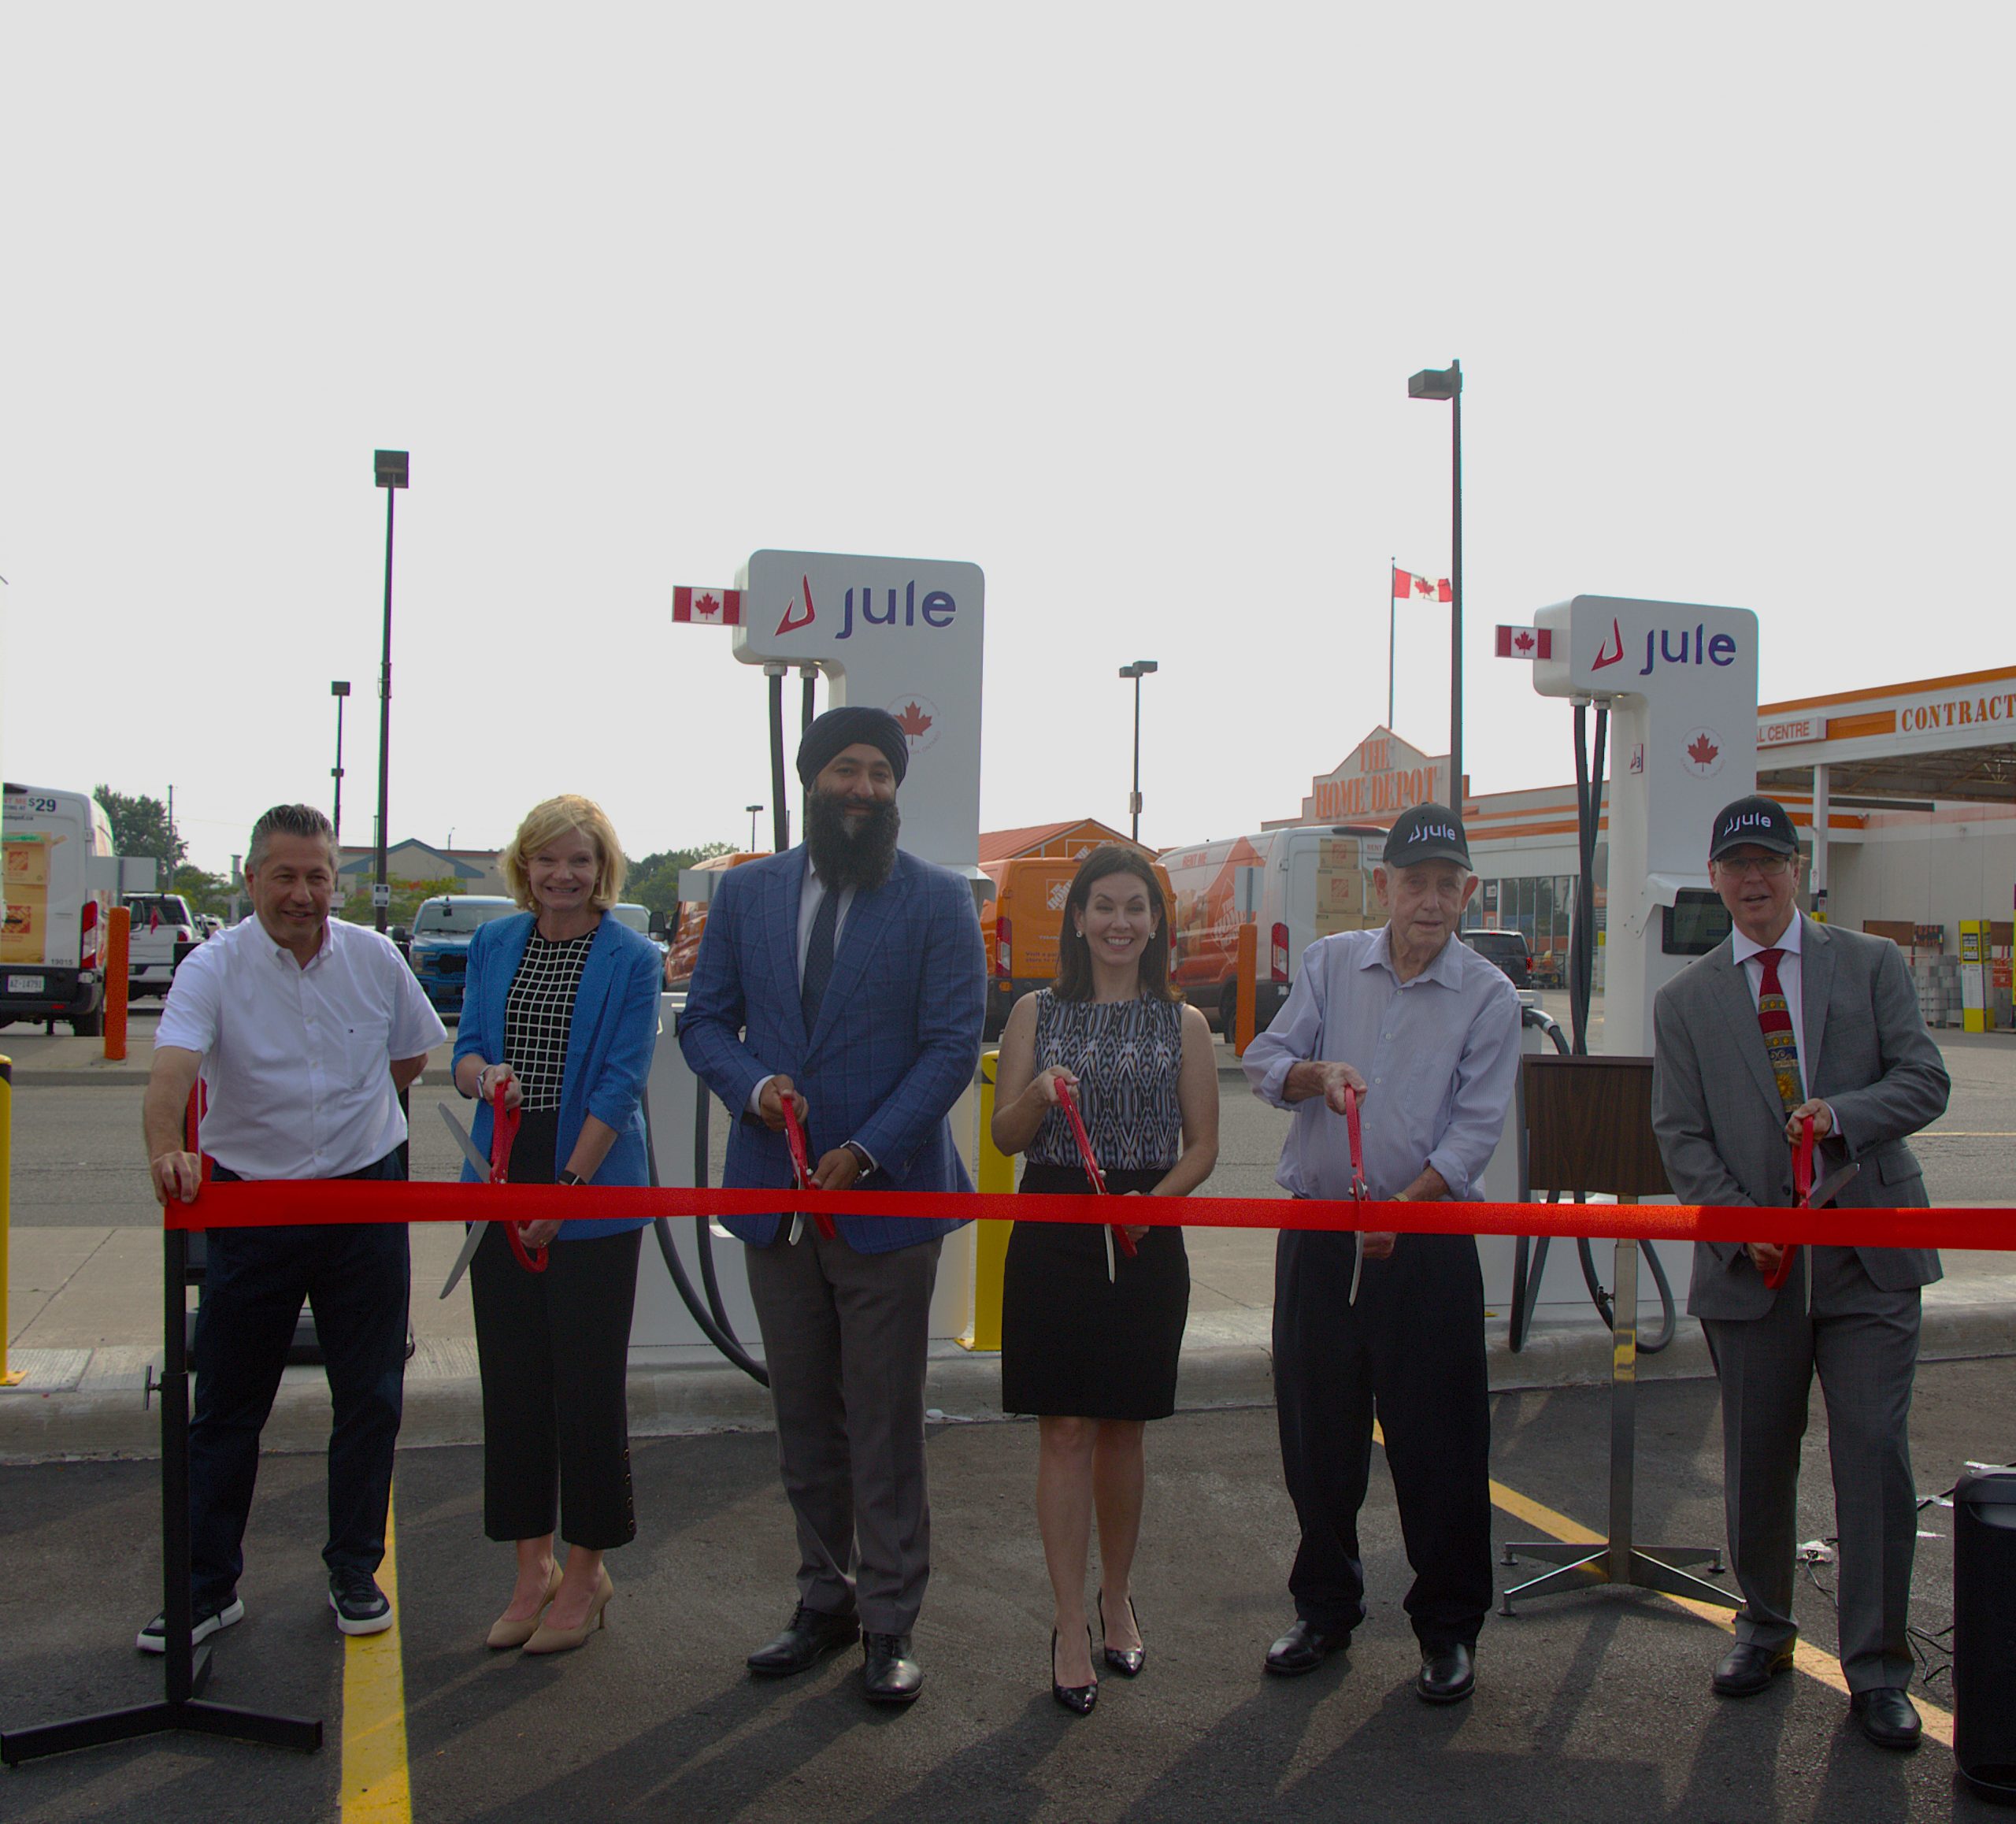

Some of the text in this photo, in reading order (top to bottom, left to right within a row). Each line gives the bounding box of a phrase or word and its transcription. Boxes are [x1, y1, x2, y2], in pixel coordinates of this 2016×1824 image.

[835, 579, 956, 640] jule
[1639, 623, 1736, 676] jule
[1768, 721, 1810, 741] CENTRE
[1902, 694, 2016, 732] CONTRACT
[1359, 738, 1391, 773] THE
[28, 797, 57, 812] $29
[1315, 766, 1437, 818] HOME DEPOT
[1183, 851, 1207, 868] RENT ME
